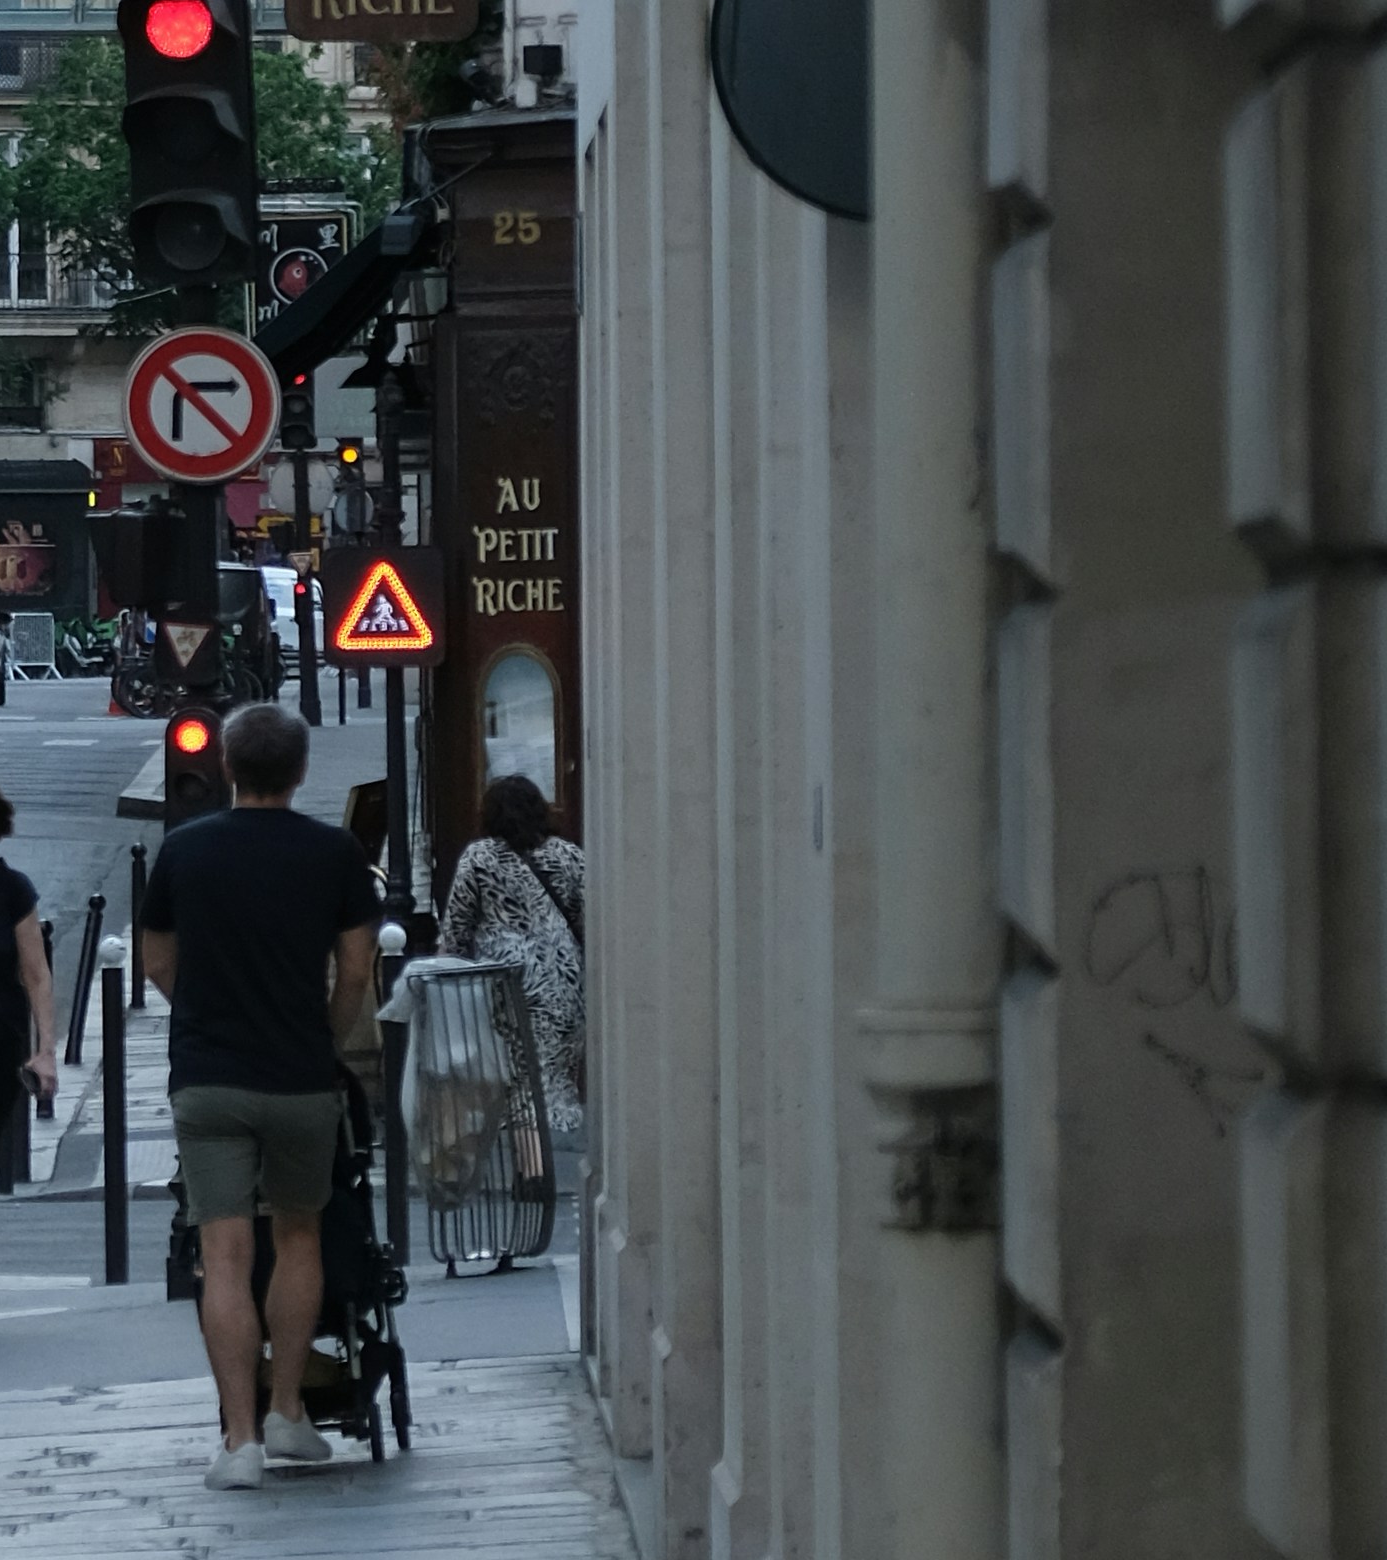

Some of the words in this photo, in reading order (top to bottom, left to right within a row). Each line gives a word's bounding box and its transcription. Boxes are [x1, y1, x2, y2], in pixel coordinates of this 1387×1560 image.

[493, 211, 541, 245] 25
[497, 478, 541, 514] AU
[473, 526, 559, 563] PETIT
[473, 577, 565, 616] RICHE
